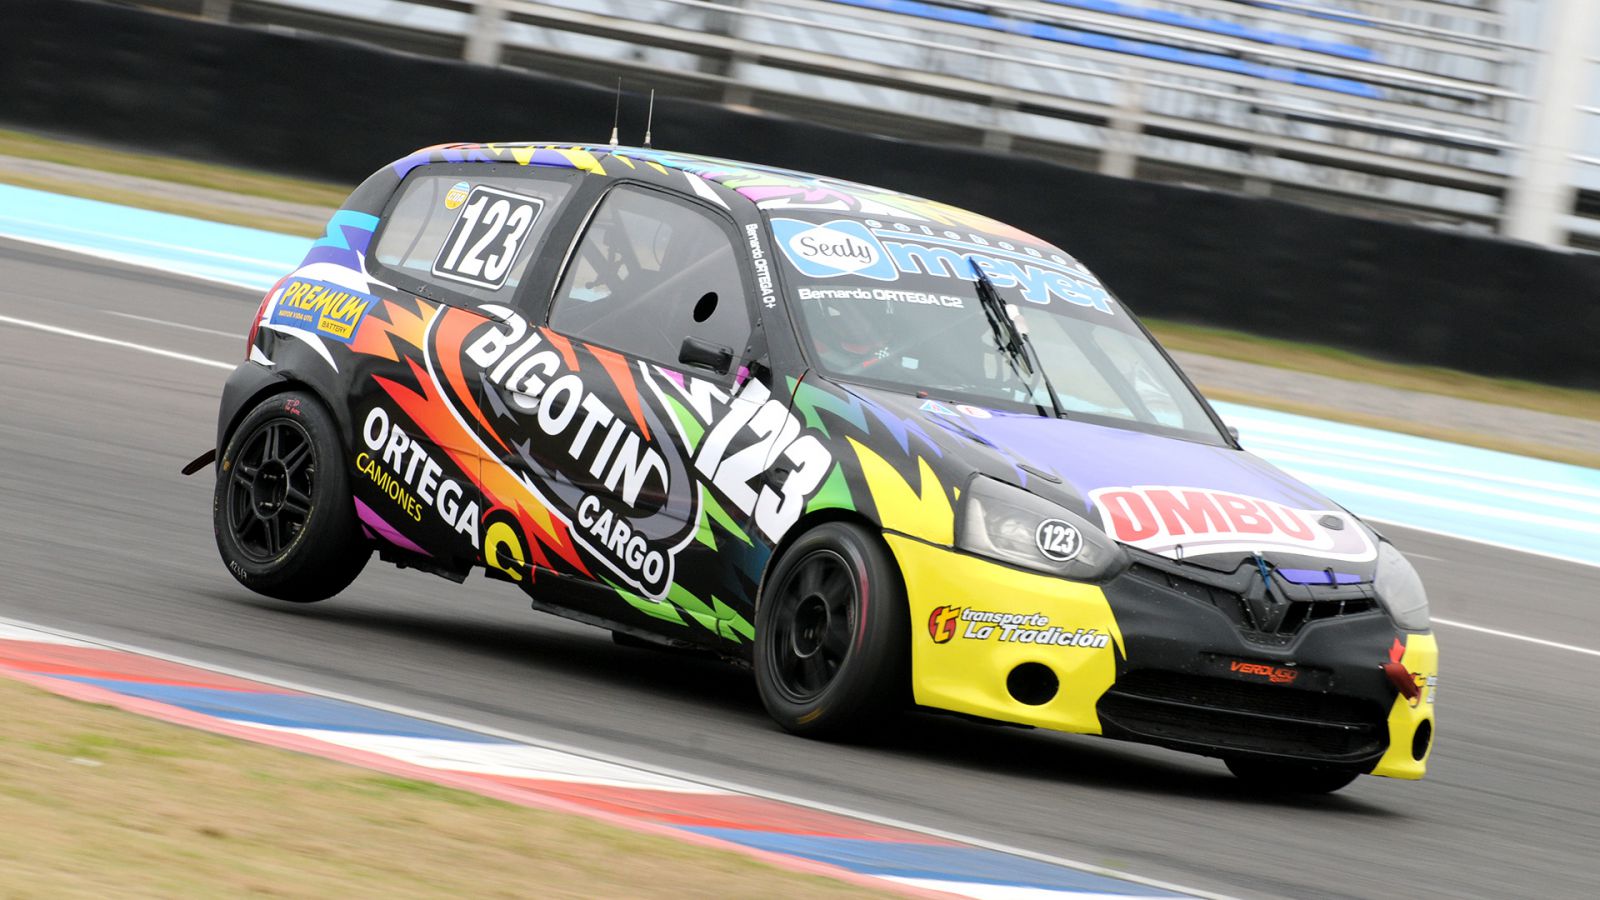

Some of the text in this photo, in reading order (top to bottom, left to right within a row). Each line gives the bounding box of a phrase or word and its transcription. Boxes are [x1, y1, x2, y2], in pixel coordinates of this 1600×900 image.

[444, 195, 532, 280] 123
[745, 223, 764, 259] Bernardo
[799, 236, 873, 264] Sealy
[754, 259, 774, 296] ORTEGA
[882, 241, 1114, 314] meyer
[279, 281, 370, 327] PREMIUM
[798, 288, 965, 309] Bernardo ORTEGA C2
[321, 320, 348, 334] BATTERY
[465, 304, 669, 511] BIGOTIN
[362, 406, 480, 550] ORTEGA
[694, 377, 832, 545] 123
[355, 453, 423, 523] CAMIONES
[1099, 490, 1315, 542] OMBU
[577, 495, 665, 585] CARGO
[1042, 523, 1075, 555] 123
[961, 607, 1049, 627] transporte
[963, 620, 1109, 648] La Tradición
[1230, 660, 1297, 679] VERDUGO
